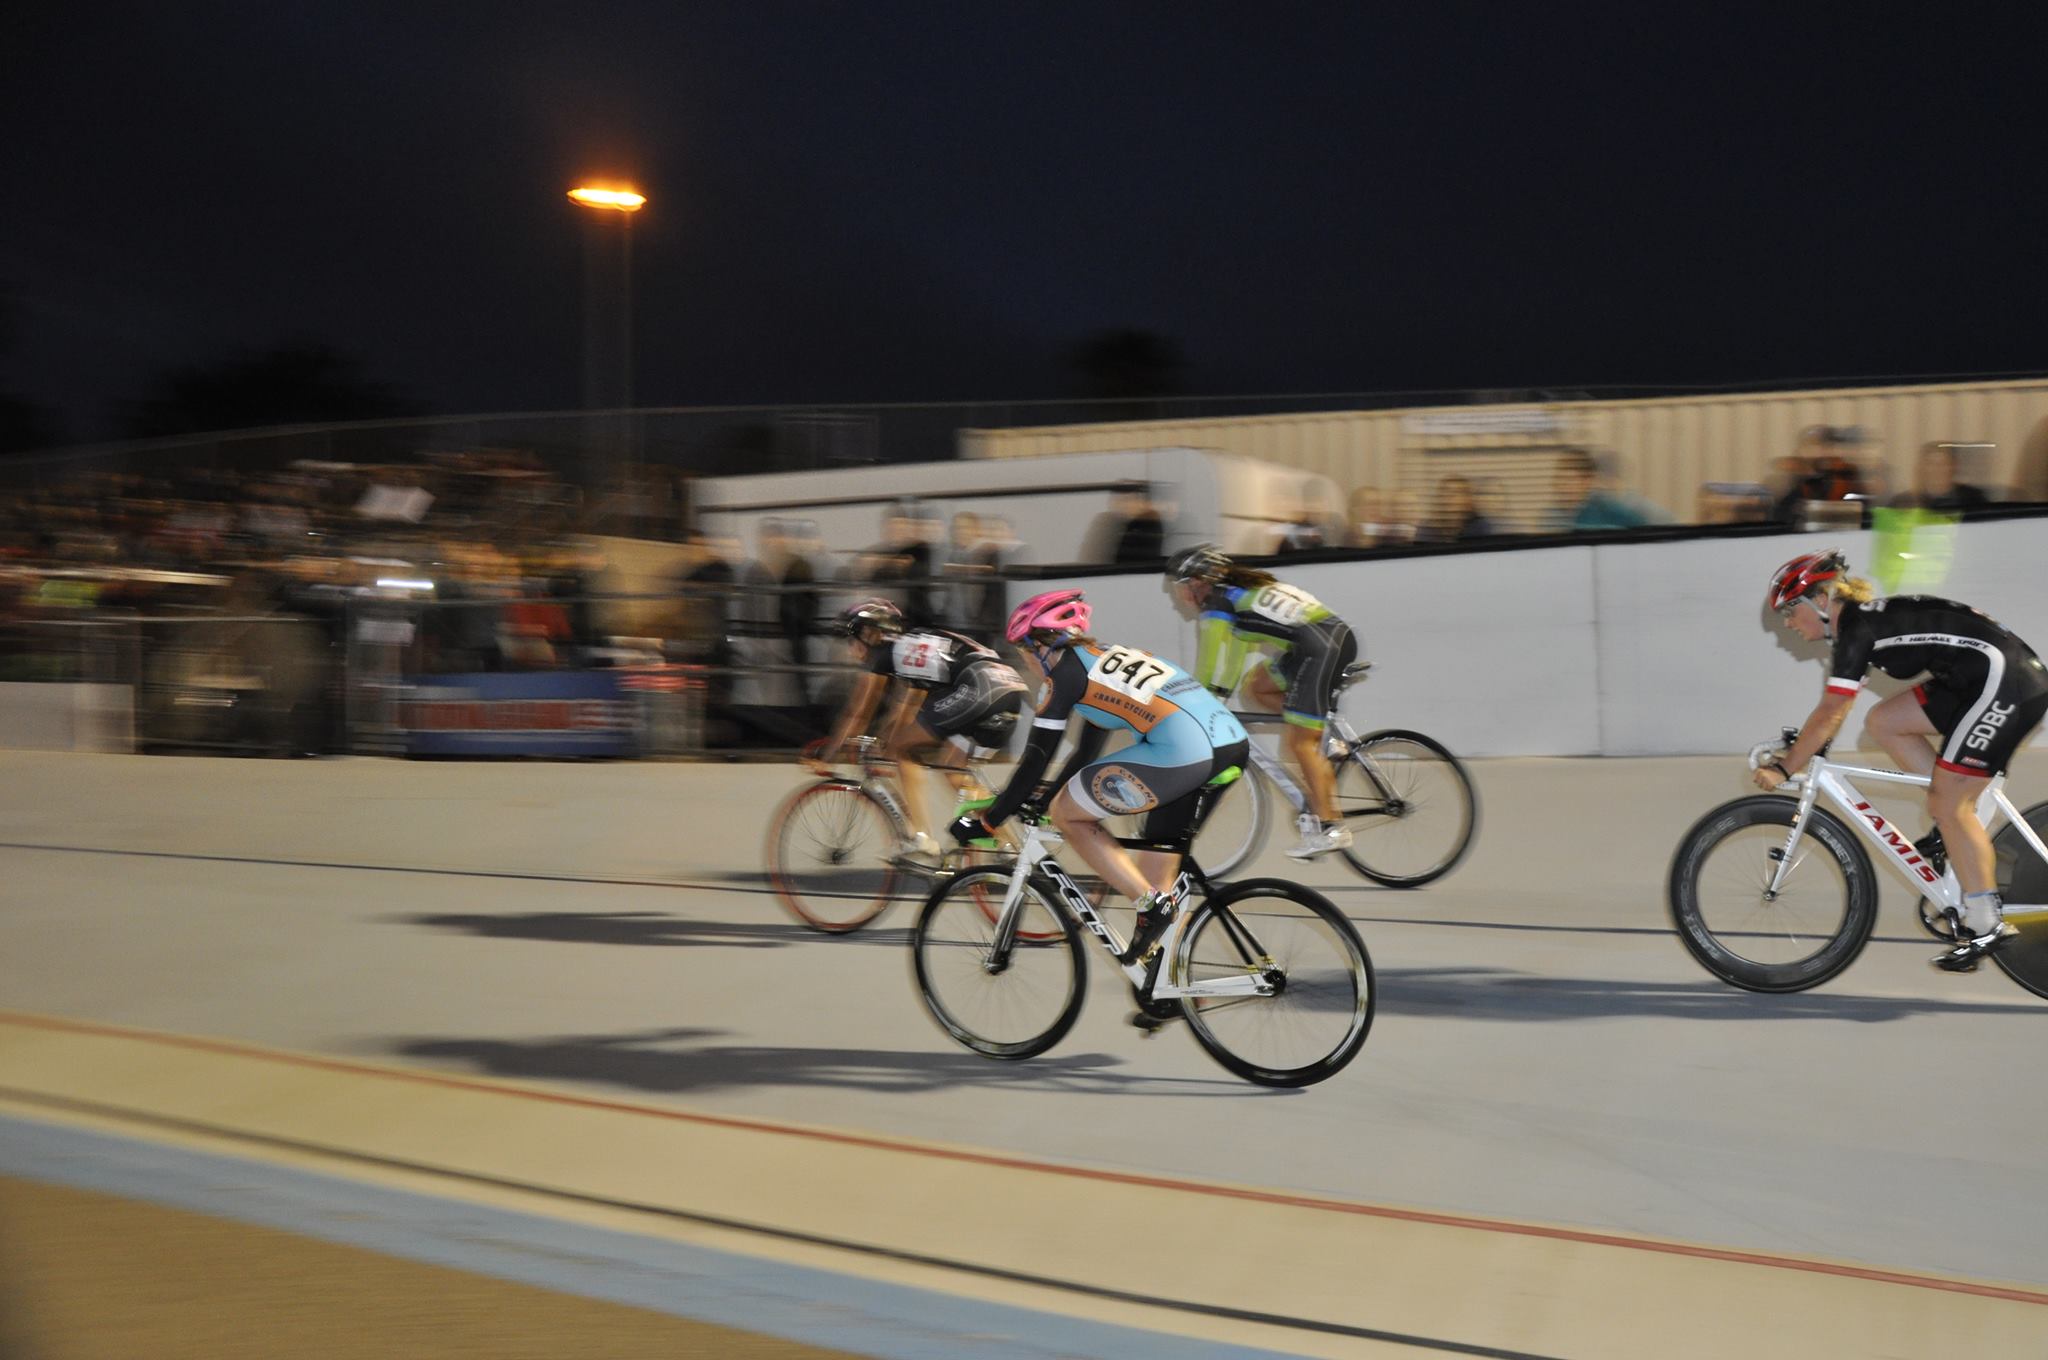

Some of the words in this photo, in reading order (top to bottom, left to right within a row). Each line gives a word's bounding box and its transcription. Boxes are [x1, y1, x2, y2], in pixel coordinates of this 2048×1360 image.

[1101, 651, 1165, 690] 647
[1123, 701, 1156, 724] CYCLING
[1965, 700, 2016, 751] SDBC
[1816, 826, 1851, 865] PLANET
[1845, 797, 1940, 883] JAMIS
